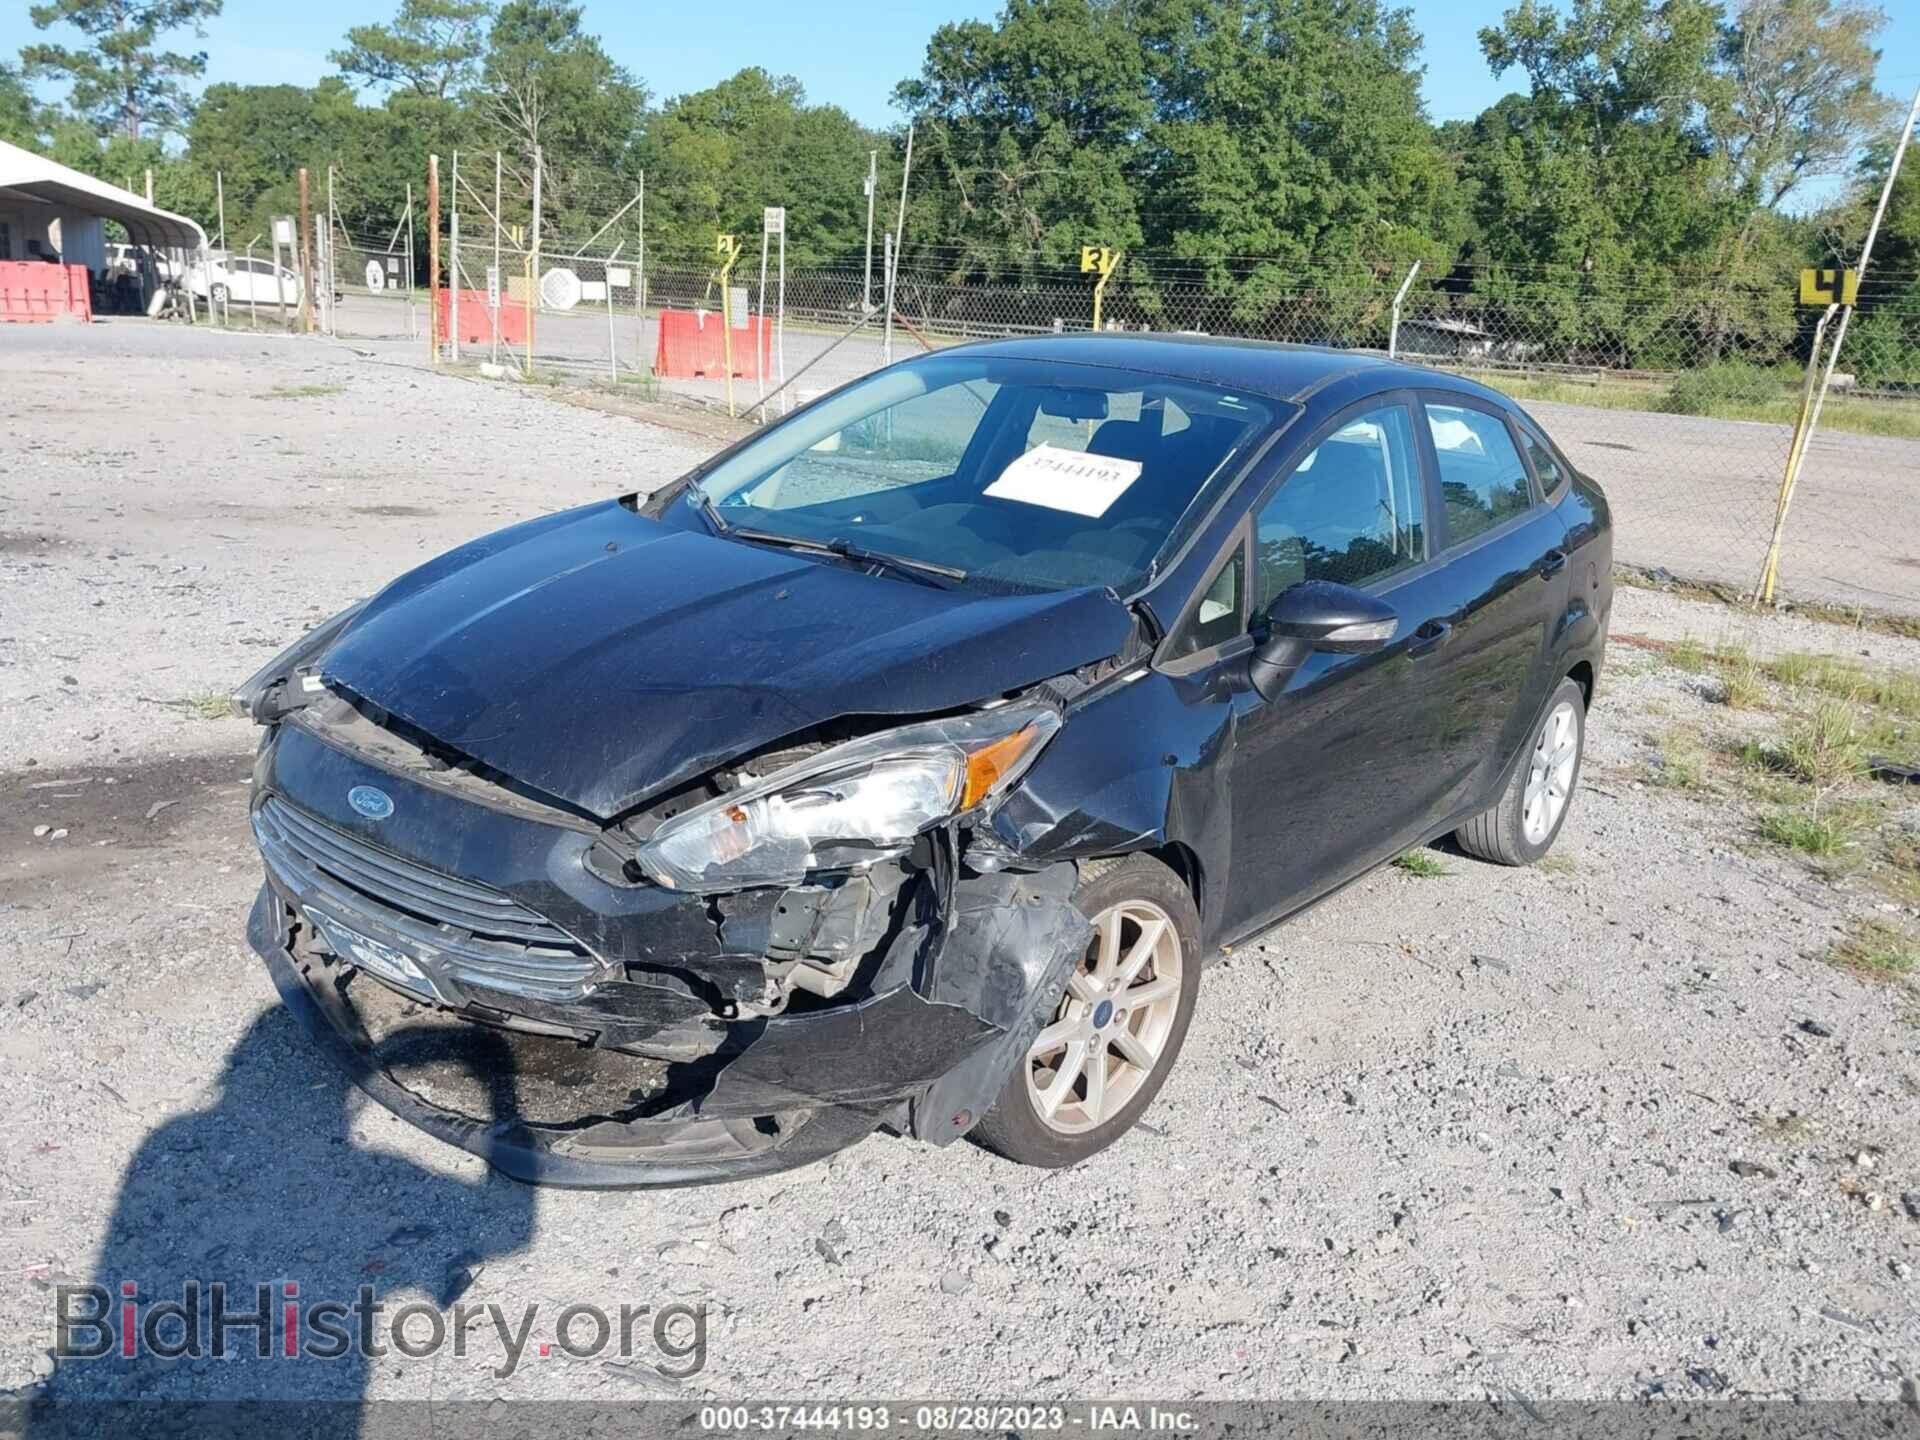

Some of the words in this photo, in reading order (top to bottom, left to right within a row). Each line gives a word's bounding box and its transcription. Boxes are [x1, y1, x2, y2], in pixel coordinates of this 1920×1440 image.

[719, 237, 729, 254] 2
[1088, 248, 1103, 272] 3
[1816, 268, 1844, 304] 4
[356, 792, 385, 811] Ford
